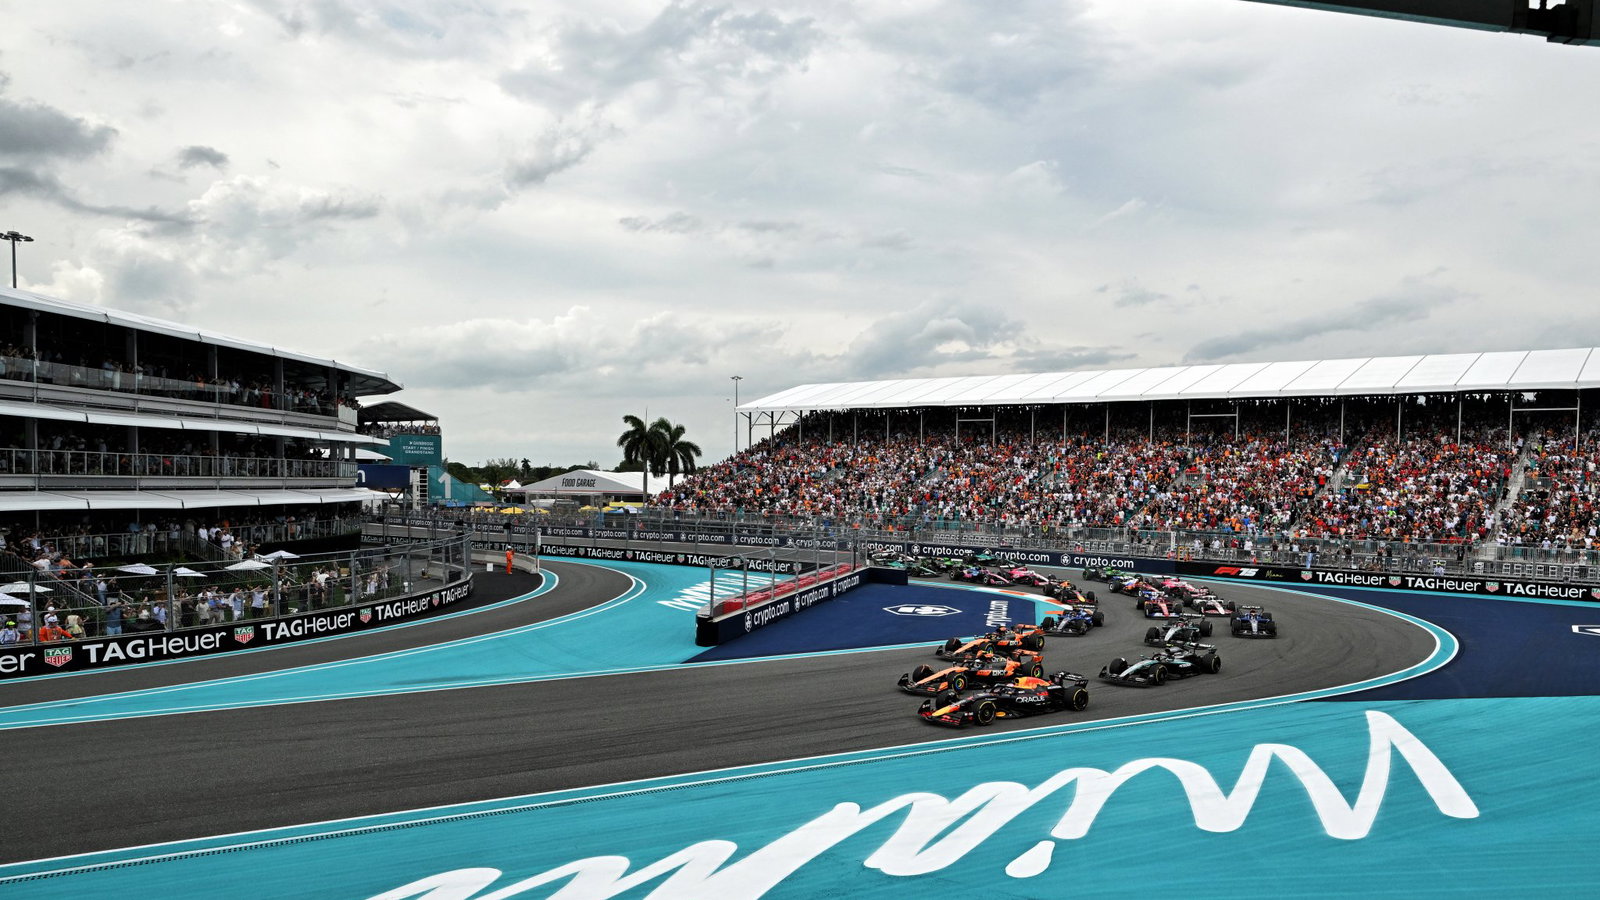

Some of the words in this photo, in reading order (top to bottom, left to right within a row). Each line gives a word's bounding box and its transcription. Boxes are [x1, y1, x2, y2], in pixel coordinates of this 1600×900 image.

[438, 472, 451, 499] 1
[561, 478, 576, 488] FOOD
[575, 478, 596, 488] GARAGE
[923, 546, 968, 556] crypto.co
[1074, 556, 1134, 570] crypto.com
[801, 586, 828, 607] crypto.com
[753, 601, 789, 626] crypto.com
[236, 626, 252, 635] TAG
[47, 648, 69, 656] TAG
[46, 655, 71, 665] HEUER
[1016, 695, 1046, 703] ORACLE
